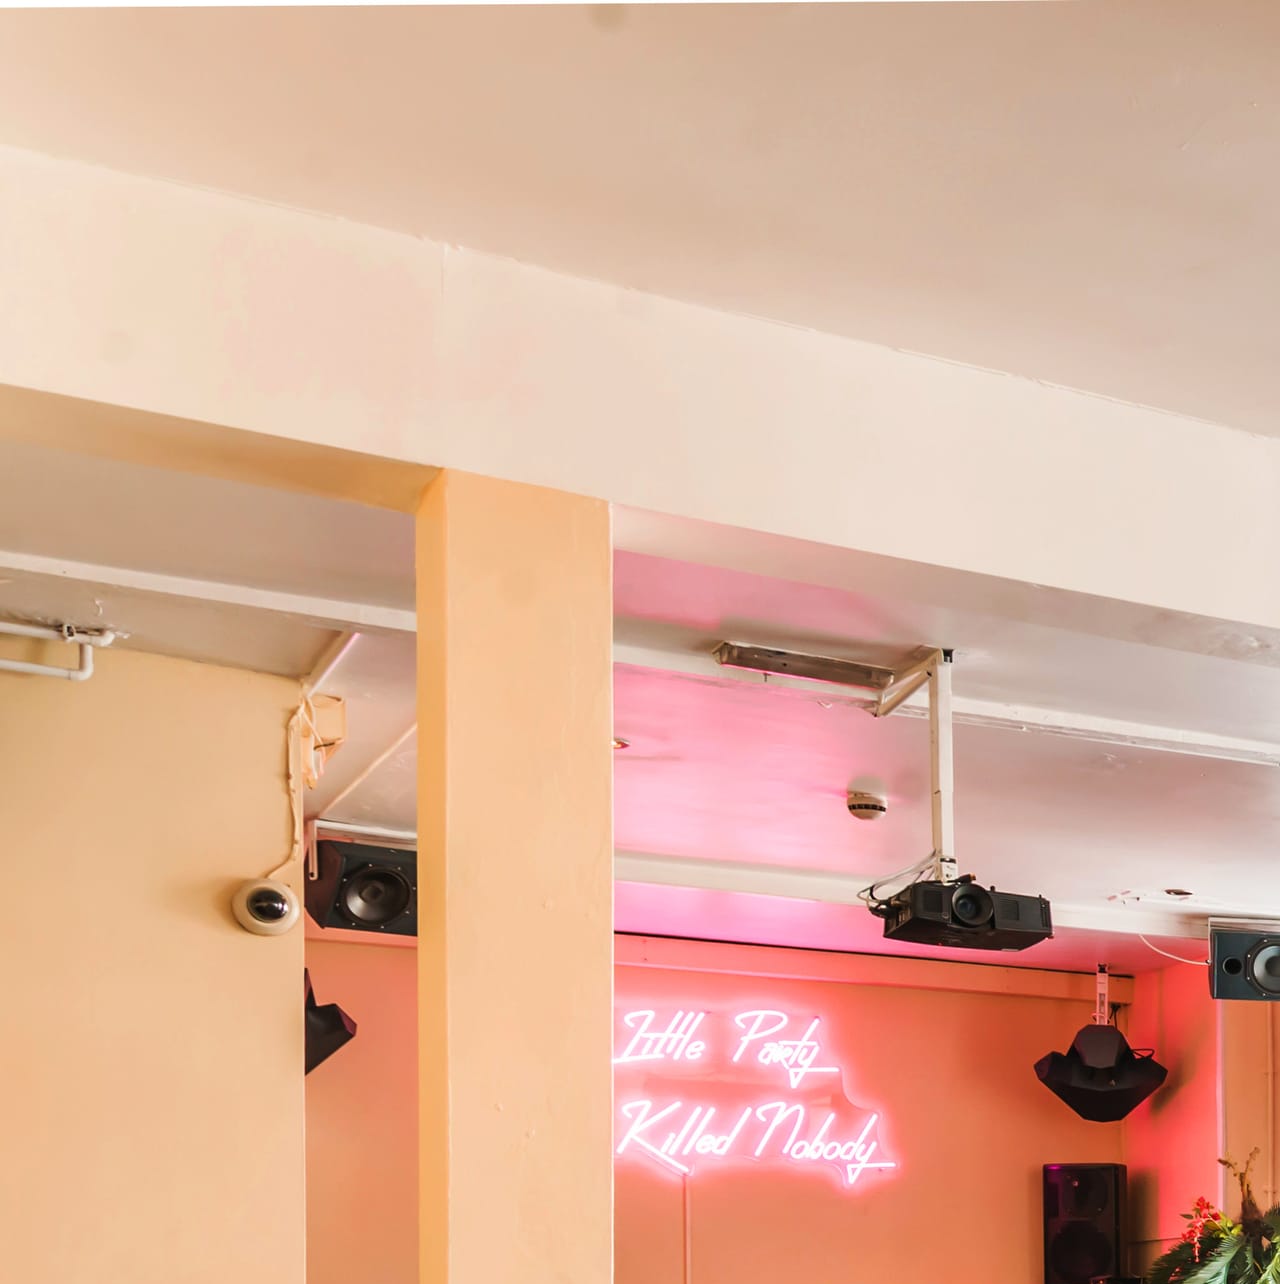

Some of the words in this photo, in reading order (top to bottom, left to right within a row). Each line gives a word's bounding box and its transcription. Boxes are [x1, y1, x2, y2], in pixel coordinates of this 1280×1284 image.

[611, 1009, 706, 1064] Little
[732, 1009, 840, 1089] Party
[616, 1099, 752, 1173] Killed
[755, 1100, 897, 1185] Nobody
